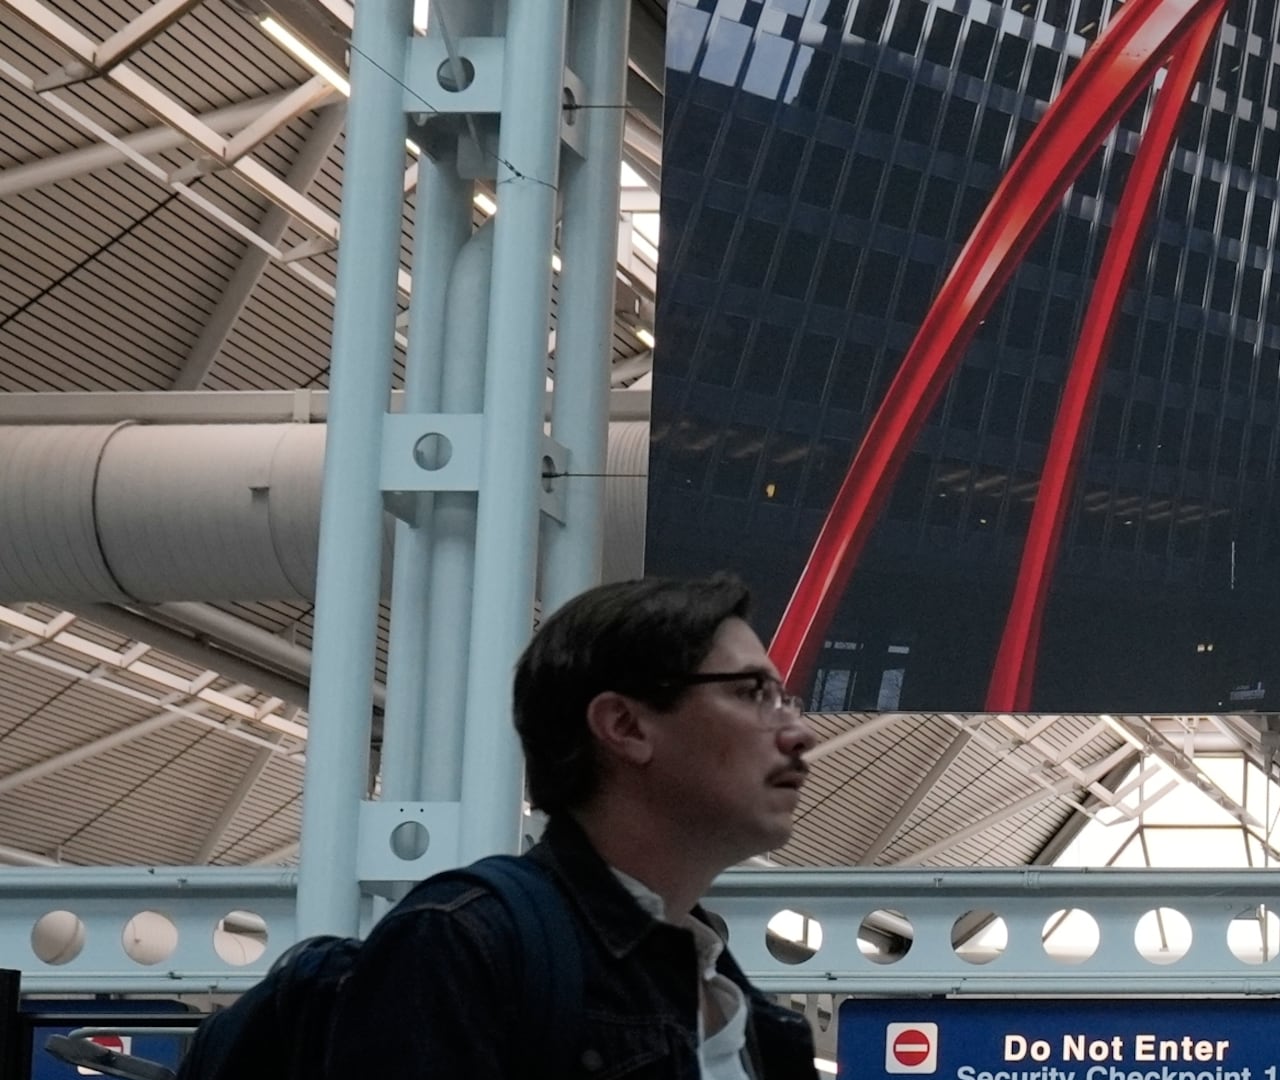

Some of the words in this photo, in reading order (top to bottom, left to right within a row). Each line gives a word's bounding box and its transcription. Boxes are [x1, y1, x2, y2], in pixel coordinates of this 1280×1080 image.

[1004, 1034, 1051, 1062] Do
[1062, 1034, 1123, 1062] Not
[1135, 1034, 1229, 1062] Enter
